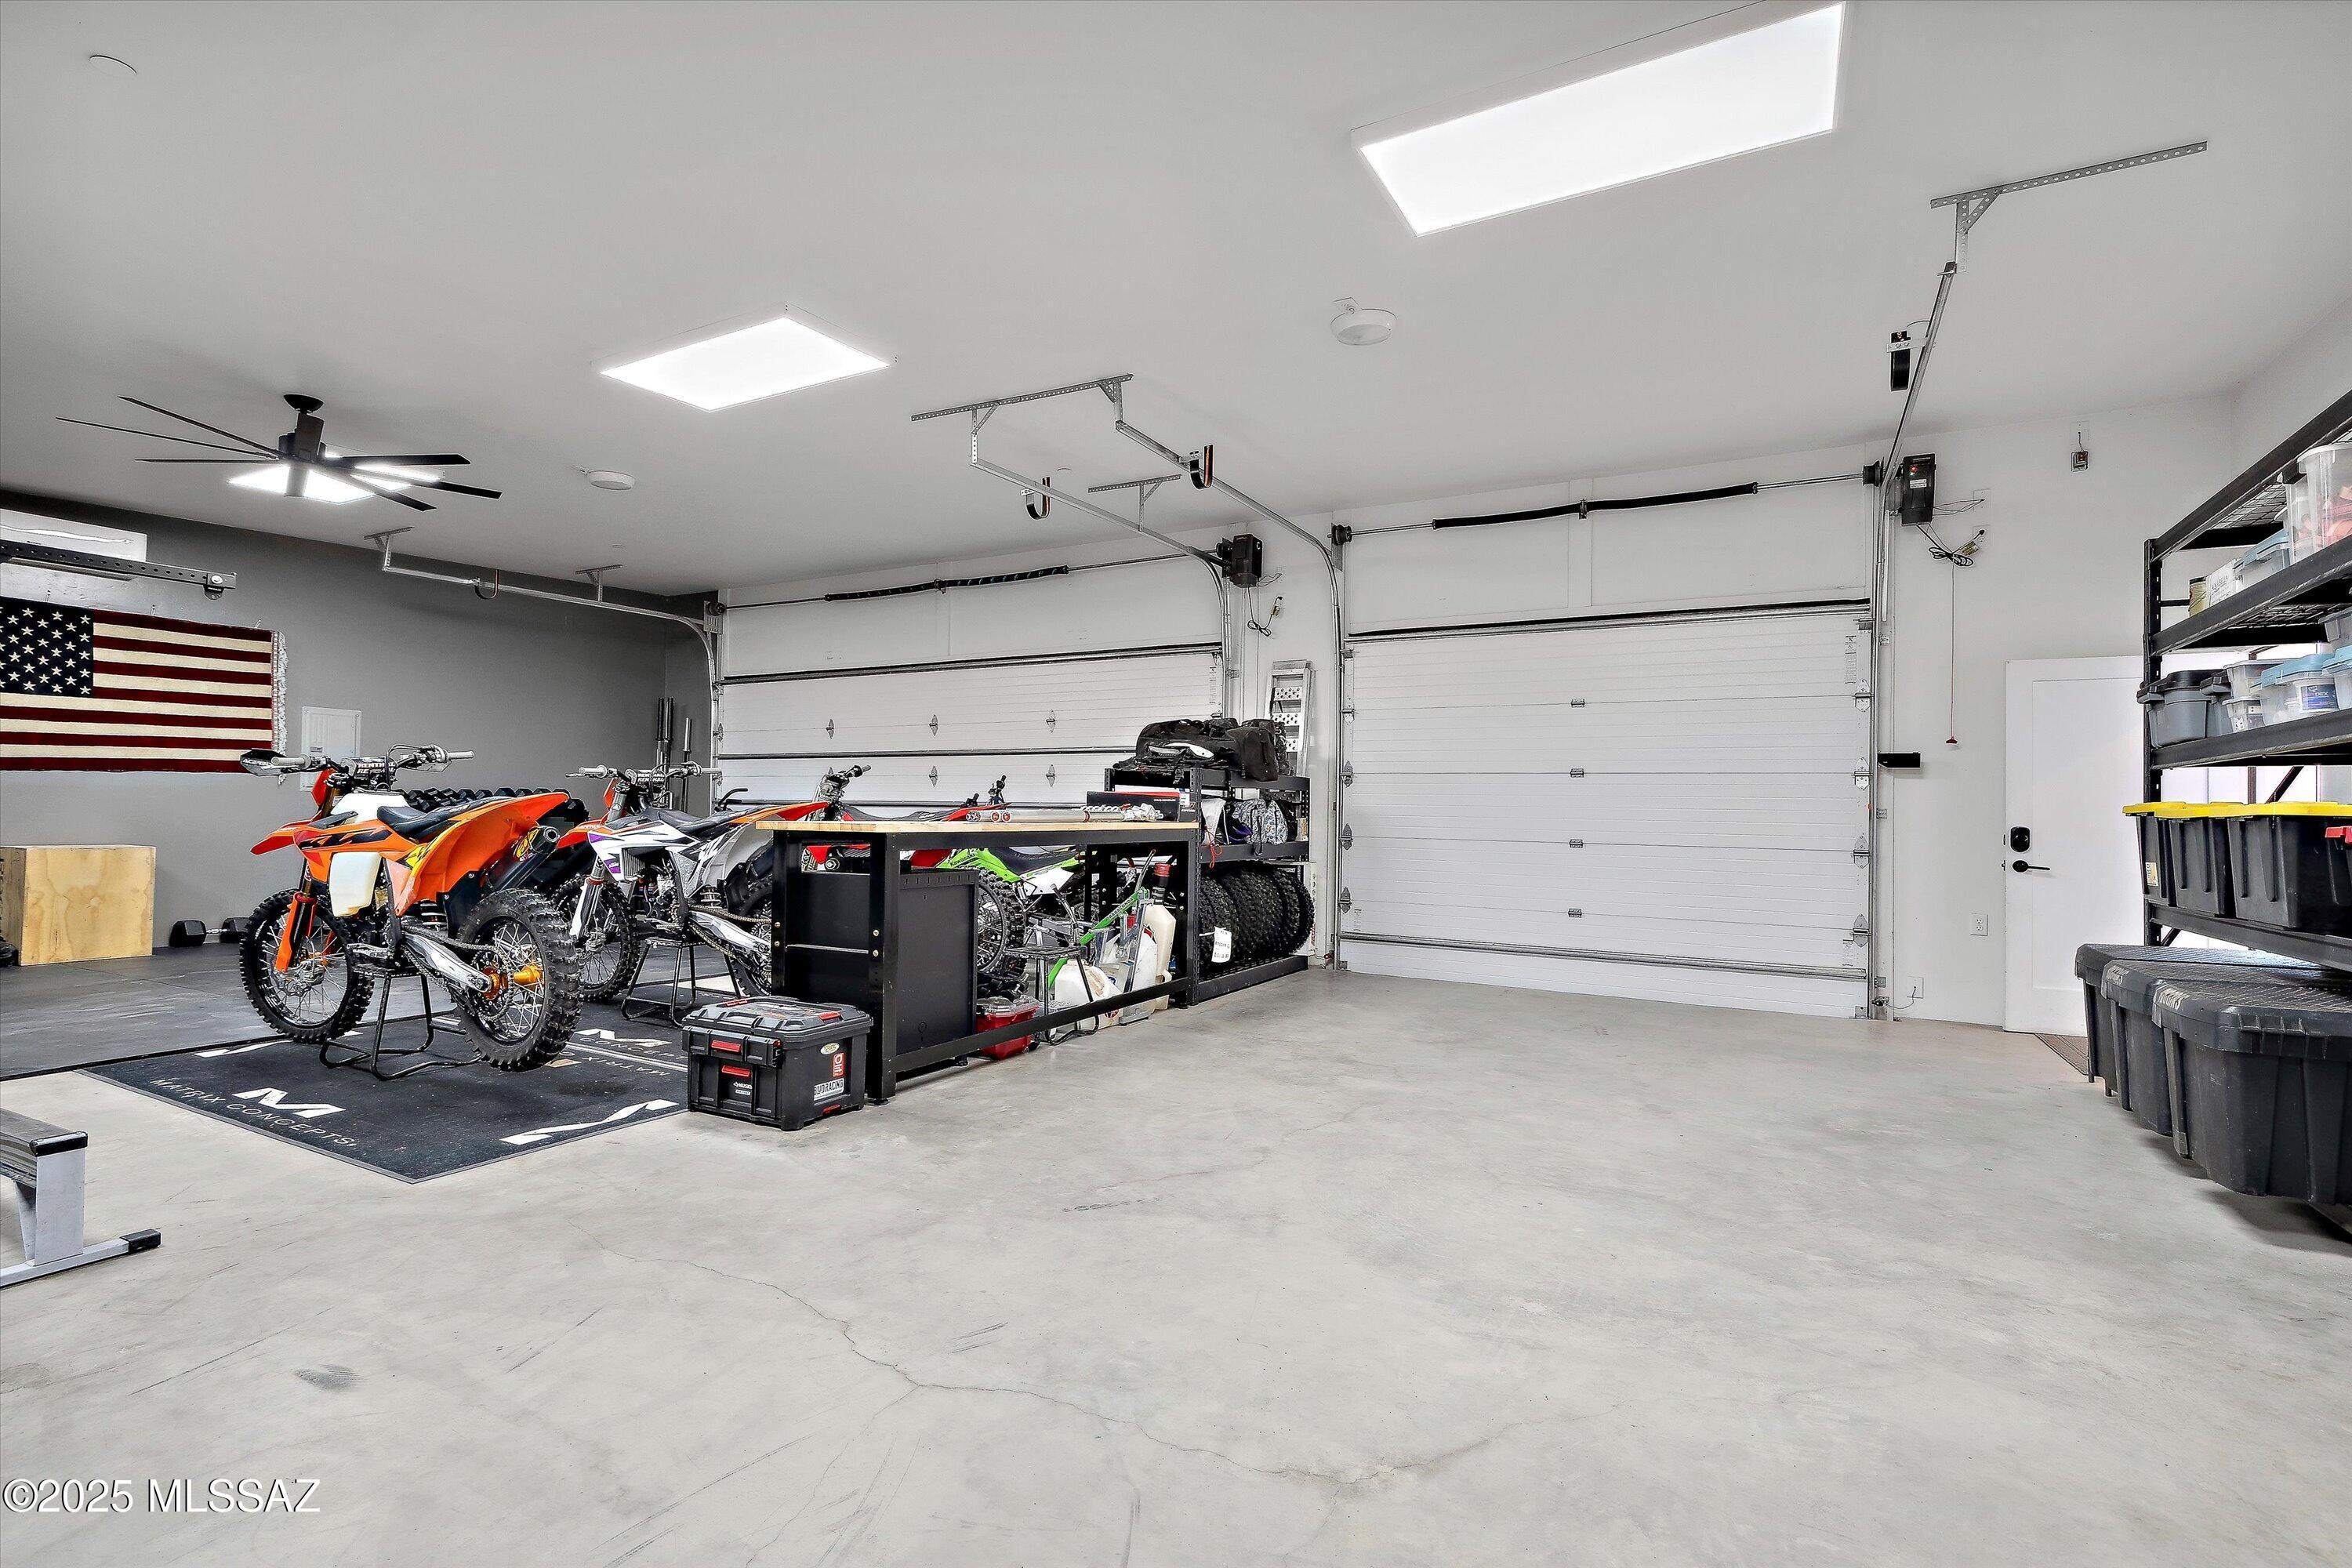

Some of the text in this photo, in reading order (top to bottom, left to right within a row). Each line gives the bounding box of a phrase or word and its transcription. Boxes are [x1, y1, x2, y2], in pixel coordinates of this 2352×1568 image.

[950, 853, 975, 867] Kawasaki
[579, 1037, 688, 1060] CONCEPT
[149, 1077, 355, 1145] MATRIX CONCEPTS
